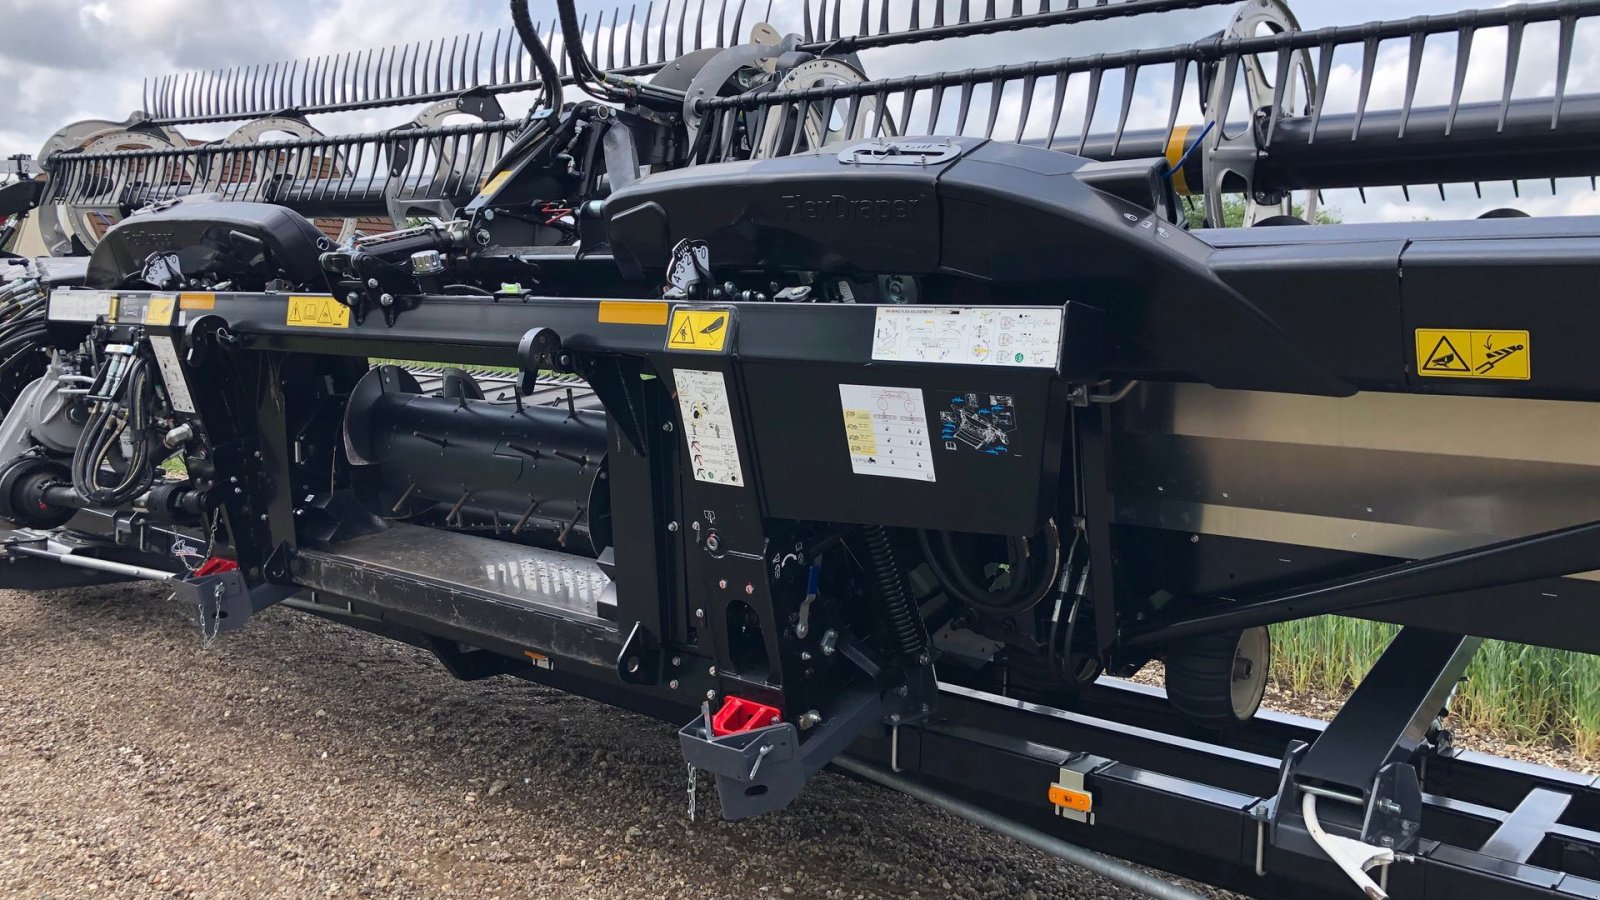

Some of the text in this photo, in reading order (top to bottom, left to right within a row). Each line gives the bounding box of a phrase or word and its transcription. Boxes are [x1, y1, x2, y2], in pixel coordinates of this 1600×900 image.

[172, 255, 176, 263] 0
[673, 275, 681, 283] 4
[677, 263, 685, 273] 3
[684, 254, 691, 266] 2
[701, 247, 706, 259] 0
